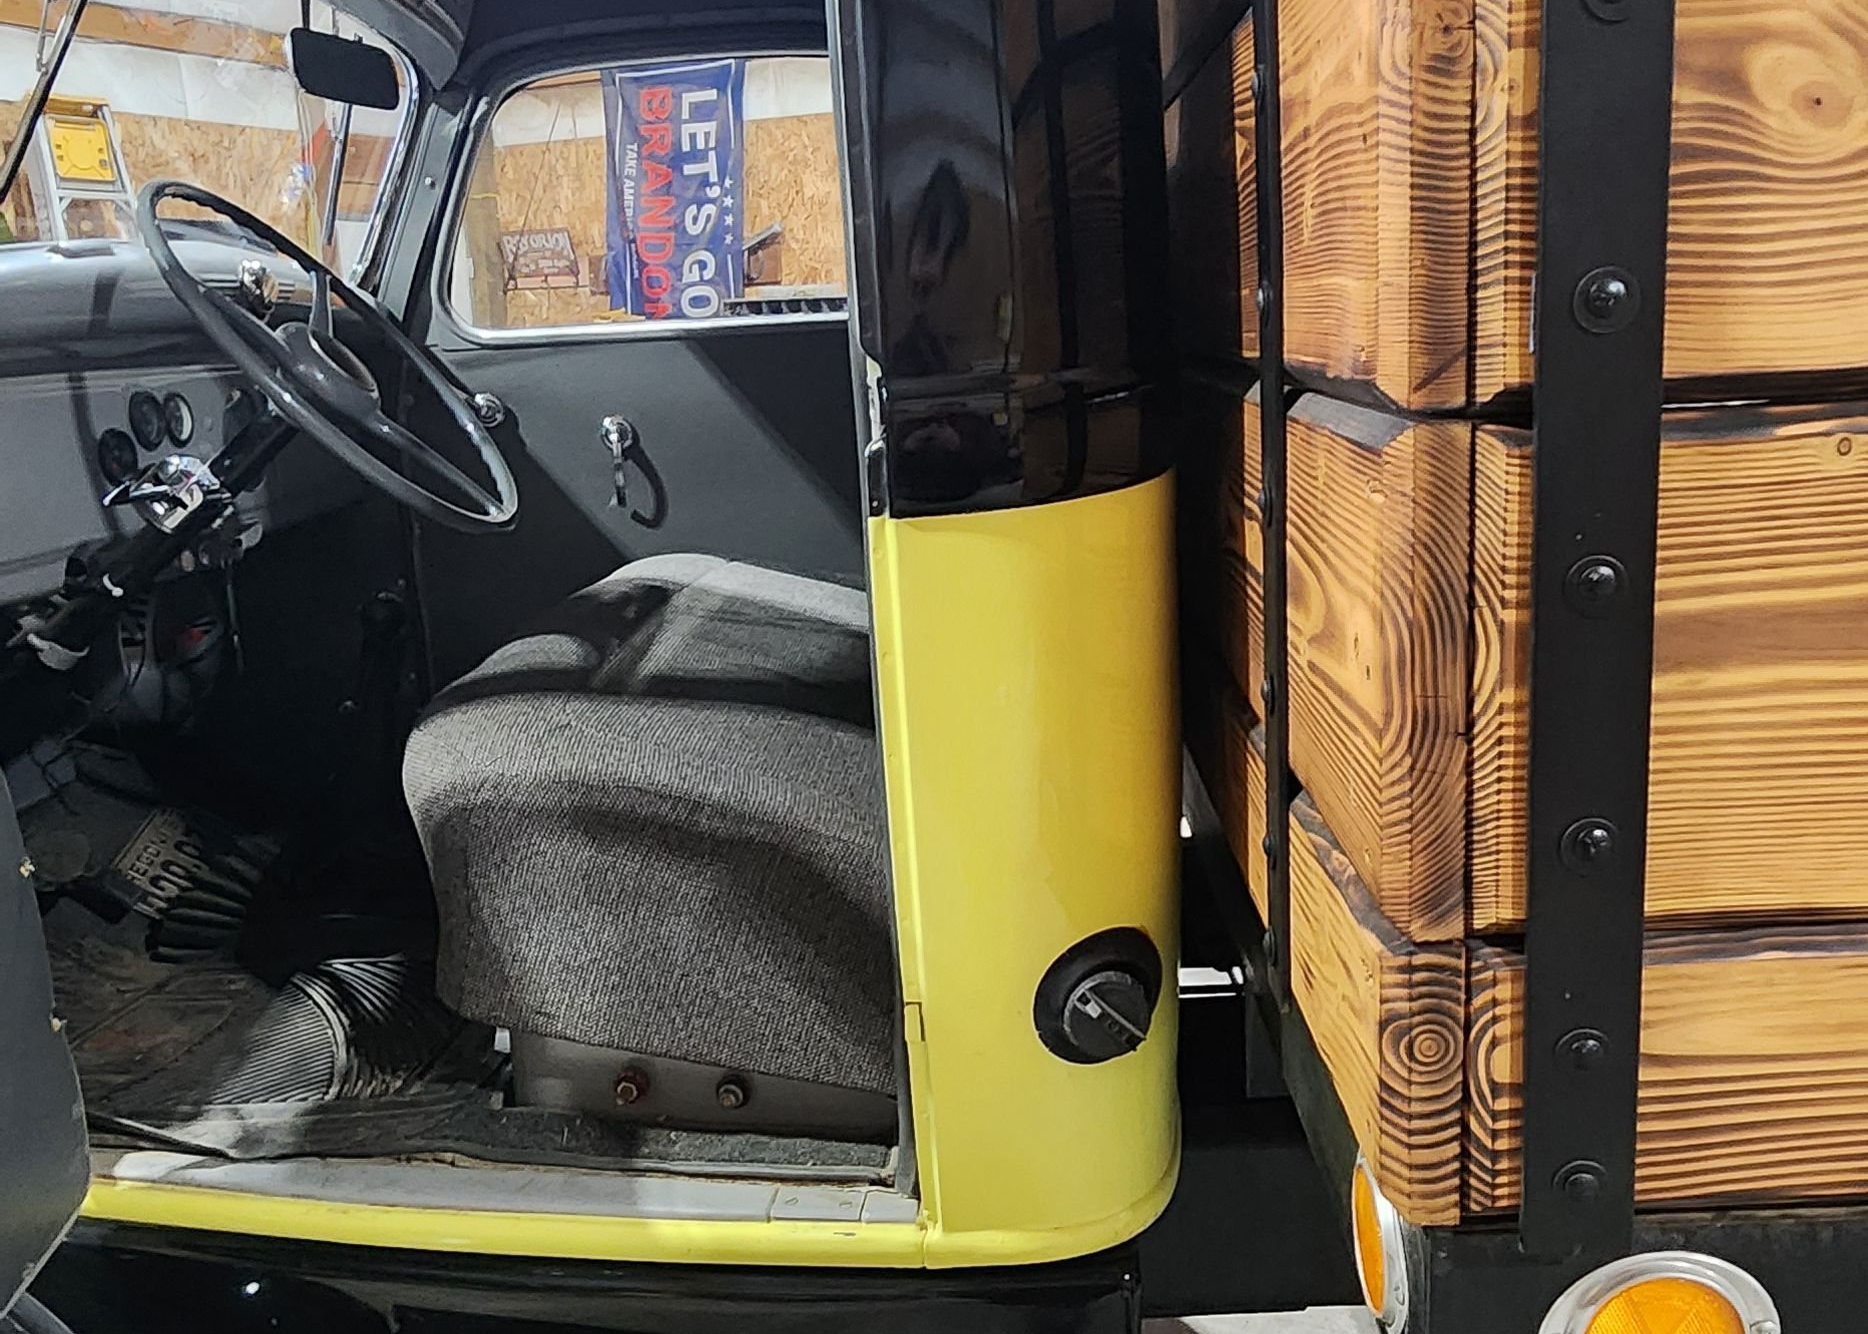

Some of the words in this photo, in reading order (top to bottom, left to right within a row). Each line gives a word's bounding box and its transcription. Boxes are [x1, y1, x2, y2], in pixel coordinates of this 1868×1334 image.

[624, 142, 639, 177] TAKE
[681, 88, 721, 236] LET'S
[680, 249, 720, 318] GO
